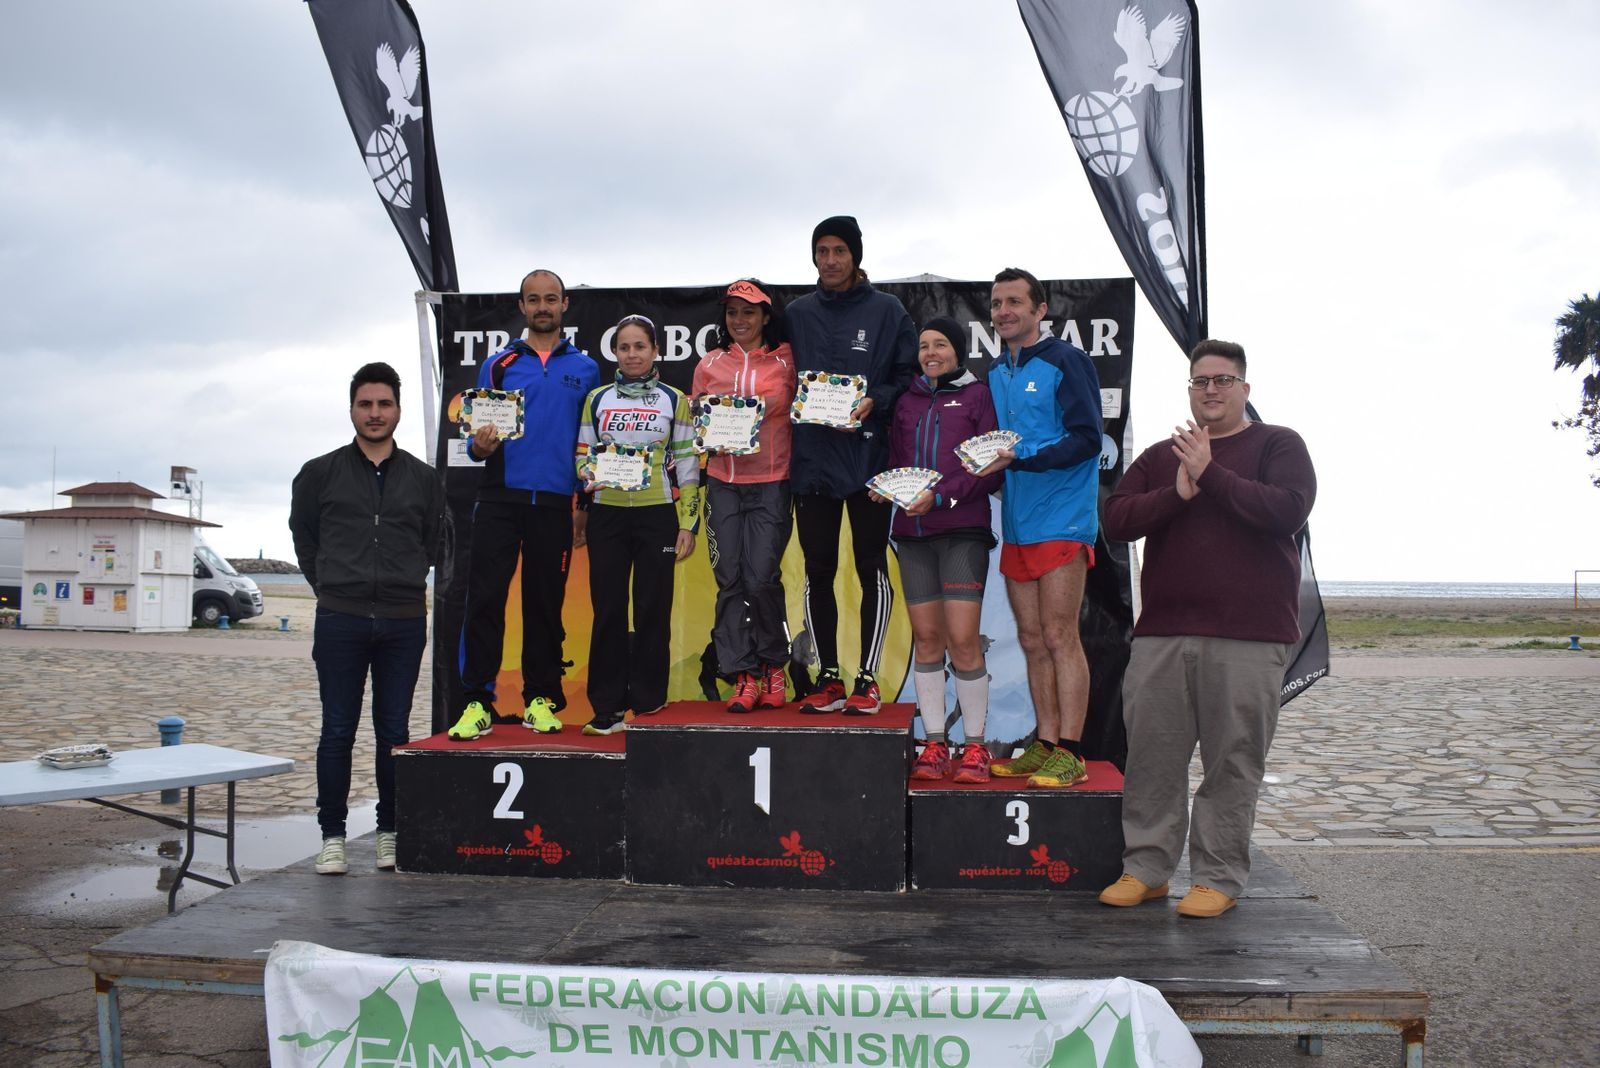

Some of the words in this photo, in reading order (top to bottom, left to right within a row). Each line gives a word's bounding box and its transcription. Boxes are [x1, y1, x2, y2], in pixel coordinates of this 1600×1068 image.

[493, 762, 524, 819] 2
[749, 747, 771, 815] 1
[1006, 800, 1030, 845] 3
[469, 973, 766, 1015] FEDERACIÓN
[780, 982, 1047, 1020] ANDALUZA
[548, 1022, 613, 1054] DE
[628, 1024, 971, 1068] MONTAÑISMO
